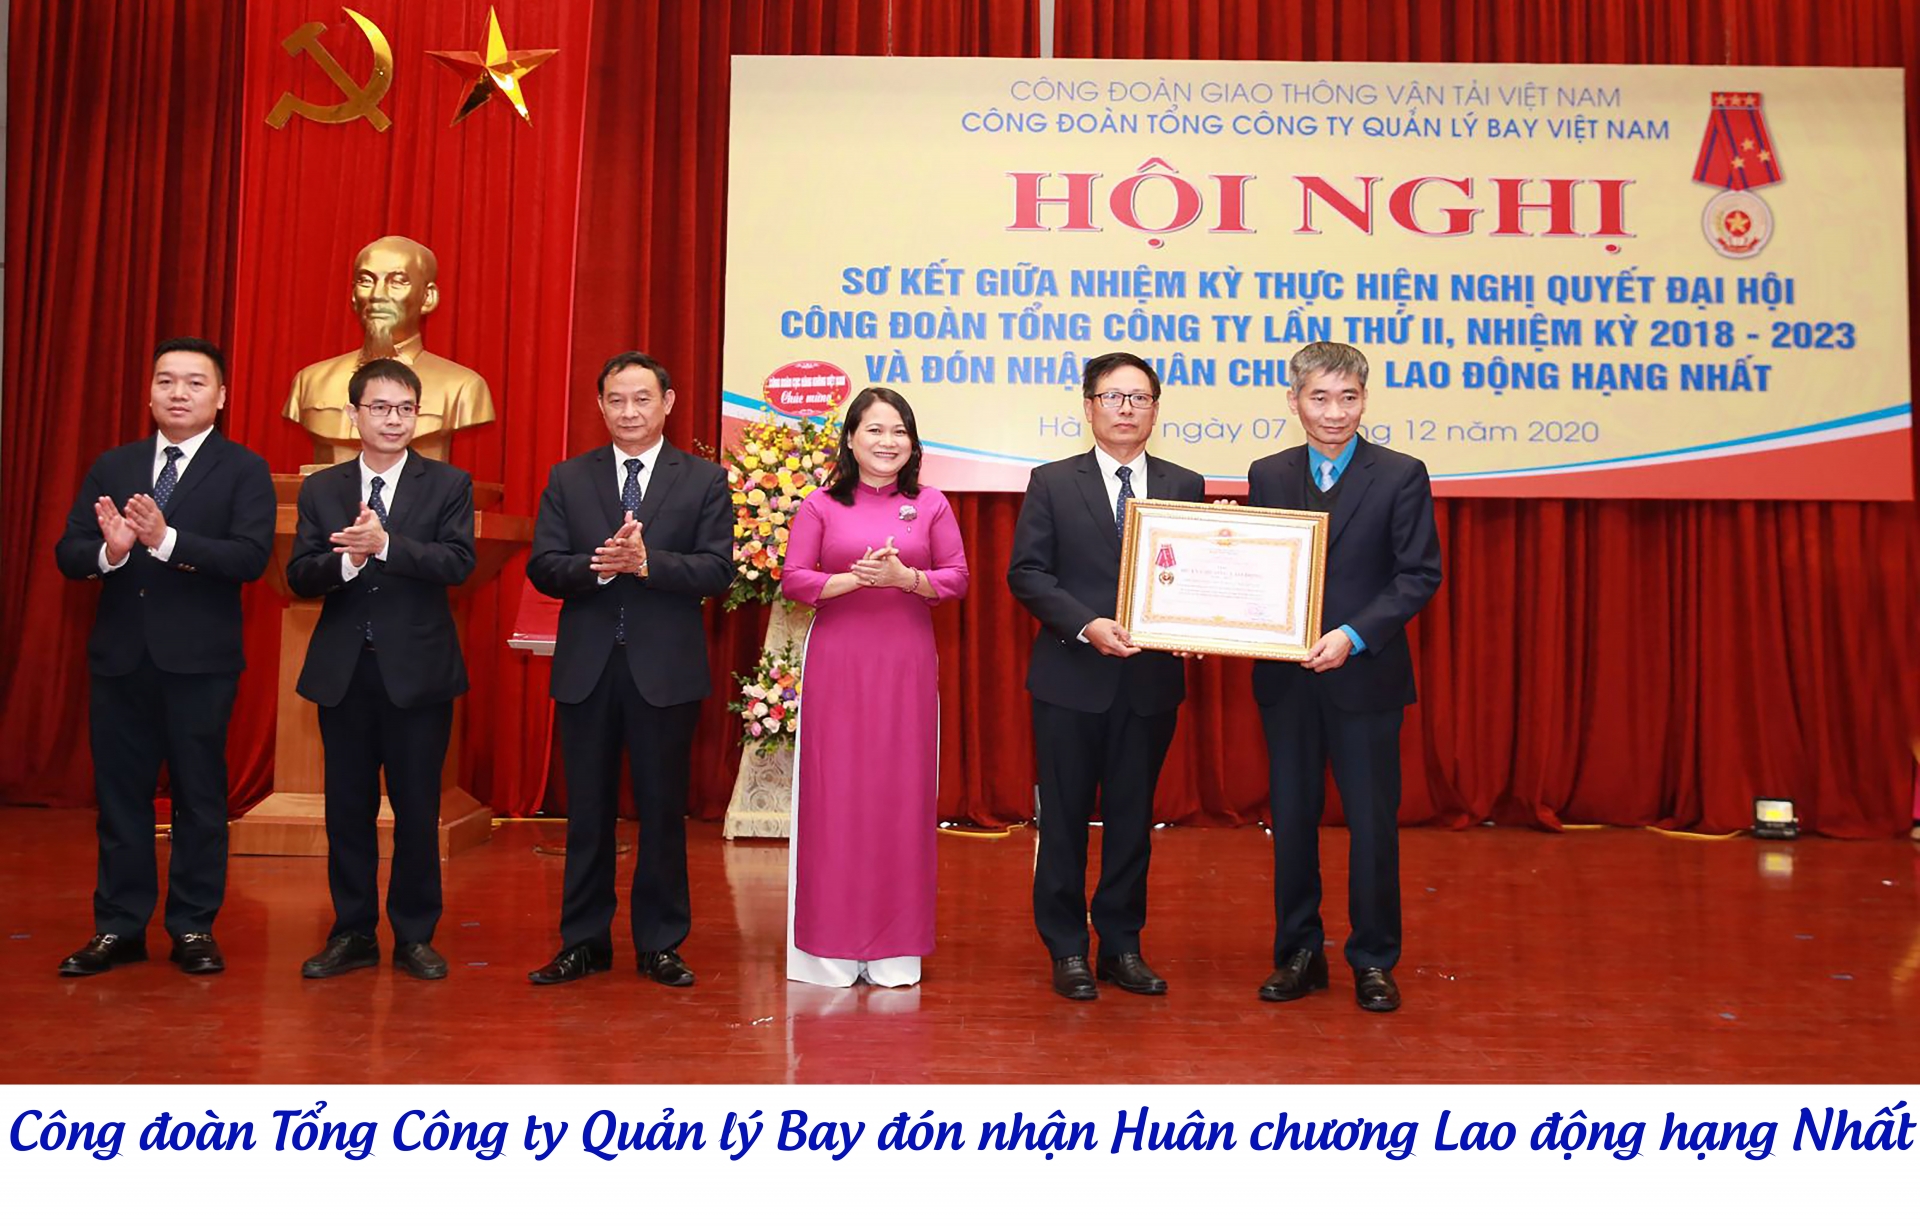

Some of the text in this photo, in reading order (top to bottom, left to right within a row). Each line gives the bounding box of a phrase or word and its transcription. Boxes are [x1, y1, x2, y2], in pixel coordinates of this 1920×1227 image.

[1010, 77, 1621, 111] CÔNG ĐOÀN GIAO THÔNG VẬN TẢI VIỆT NAM
[961, 104, 1670, 143] CÔNG ĐOÀN TỔNG CÔNG TY QUẢN LÝ BAY VIỆT NAM
[1005, 157, 1637, 254] HỘI NGHỊ
[841, 258, 1795, 310] SƠ KẾT GIỮA NHIỆM KỲ THỰC HIỆN NGHỊ QUYẾT ĐẠI HỘI
[781, 305, 878, 339] CÔNG
[888, 306, 987, 340] ĐOÀN
[997, 300, 1091, 341] TỔNG
[1102, 305, 1200, 343] CÔNG
[1212, 314, 1252, 343] TY
[1263, 305, 1332, 345] LẦN
[1344, 308, 1415, 346] THỨ
[1421, 316, 1455, 348] II,
[1467, 313, 1582, 353] NHIỆM
[1594, 313, 1637, 347] KỲ
[1650, 320, 1735, 348] 2018
[1771, 321, 1857, 349] 2023
[865, 348, 911, 384] VÀ
[921, 349, 995, 385] ĐÓN
[1007, 351, 1094, 390] NHẬ
[1385, 360, 1452, 389] LAO
[1462, 357, 1560, 394] ĐỘNG
[1571, 362, 1669, 396] HẠNG
[1679, 354, 1773, 392] NHẤT
[1039, 416, 1082, 438] Hà
[1163, 417, 1243, 444] ngày
[1252, 418, 1287, 440] 07
[1406, 419, 1437, 442] 12
[1447, 421, 1518, 443] năm
[1527, 421, 1600, 444] 2020
